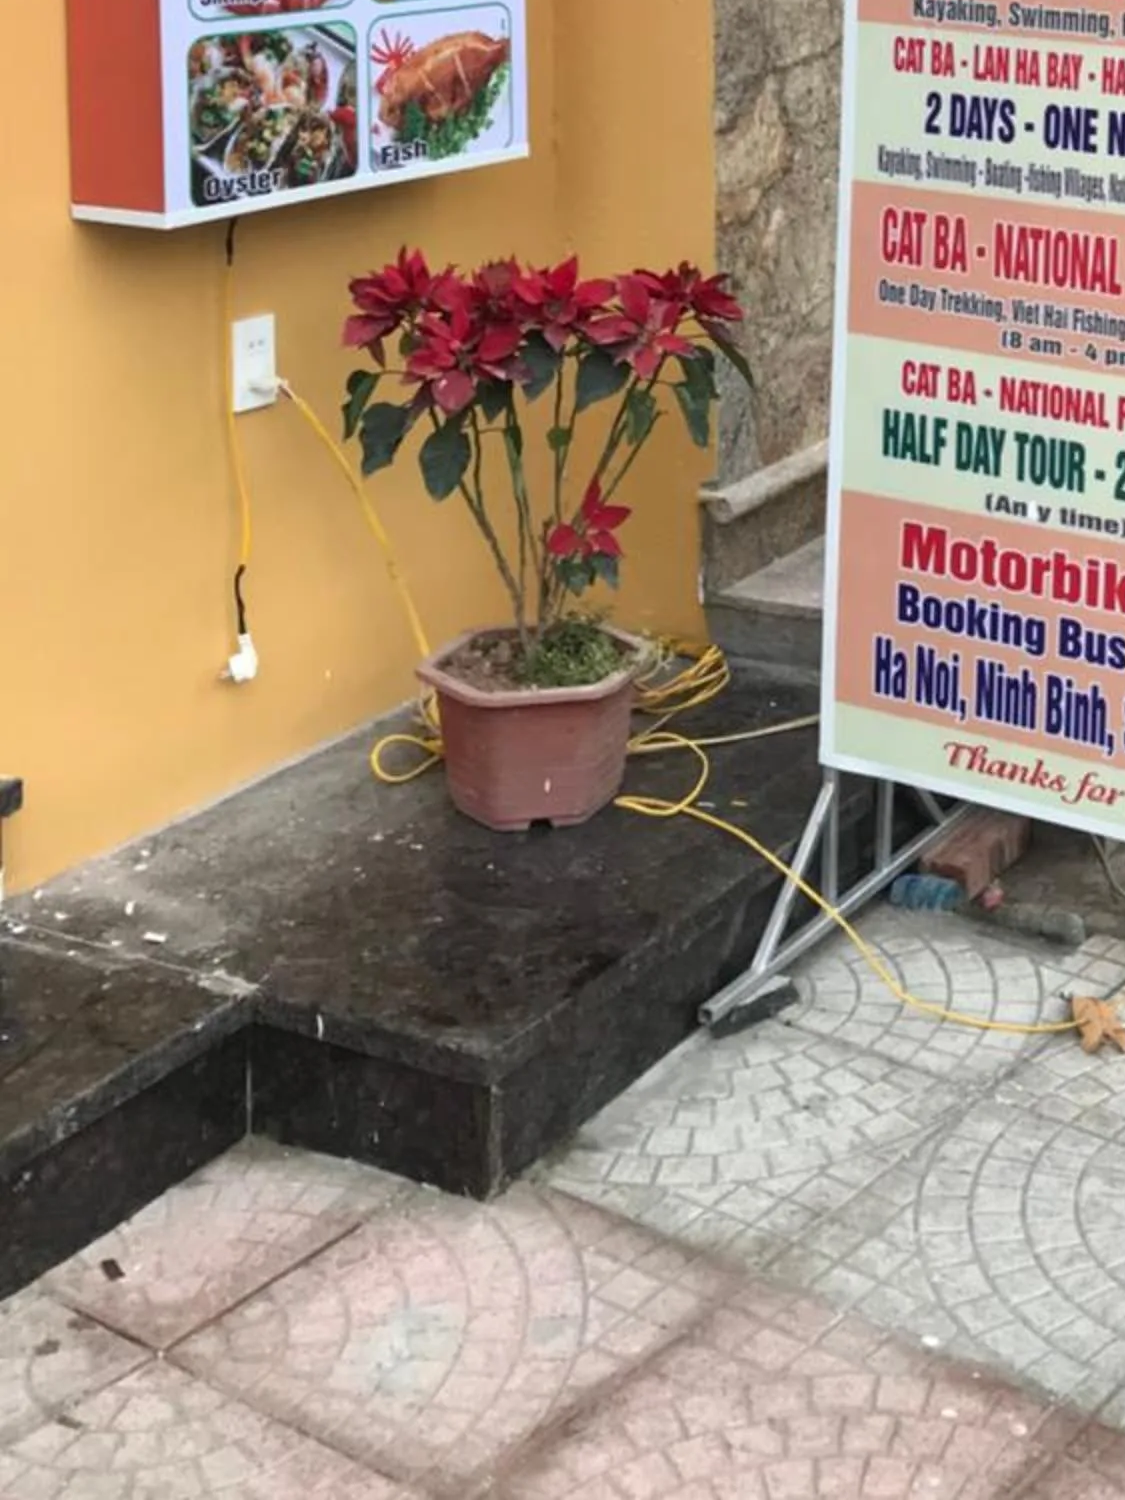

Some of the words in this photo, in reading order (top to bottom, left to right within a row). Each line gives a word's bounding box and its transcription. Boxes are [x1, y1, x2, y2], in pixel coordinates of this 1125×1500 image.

[1008, 3, 1115, 38] Swimming,
[894, 37, 925, 73] CAT
[931, 41, 955, 75] BA
[973, 43, 1009, 80] LAN
[1016, 49, 1040, 82] HA
[1047, 51, 1083, 89] BAY
[380, 139, 427, 165] Fish
[925, 92, 940, 133] 2
[950, 94, 1015, 142] DAYS
[1044, 104, 1097, 152] ONE
[205, 170, 281, 200] Oyster
[882, 208, 926, 263] CAT
[934, 213, 966, 272] BA
[994, 223, 1121, 298] NATIONAL
[879, 279, 905, 304] One
[910, 285, 936, 310] Day
[941, 289, 1007, 323] Trekking,
[1012, 300, 1040, 325] Viet
[1044, 305, 1068, 329] Hai
[902, 360, 941, 398] CAT
[947, 368, 977, 404] BA
[1000, 377, 1108, 428] NATIONAL
[883, 408, 946, 464] HALF
[956, 420, 1008, 476] DAY
[1014, 431, 1086, 492] TOUR
[897, 583, 1047, 655] Booking
[874, 636, 907, 698] Ha
[915, 646, 966, 720] Noi,
[975, 659, 1036, 730] Ninh
[1046, 675, 1113, 754] Binh,
[944, 740, 1066, 792] Thanks
[1066, 771, 1124, 805] for
